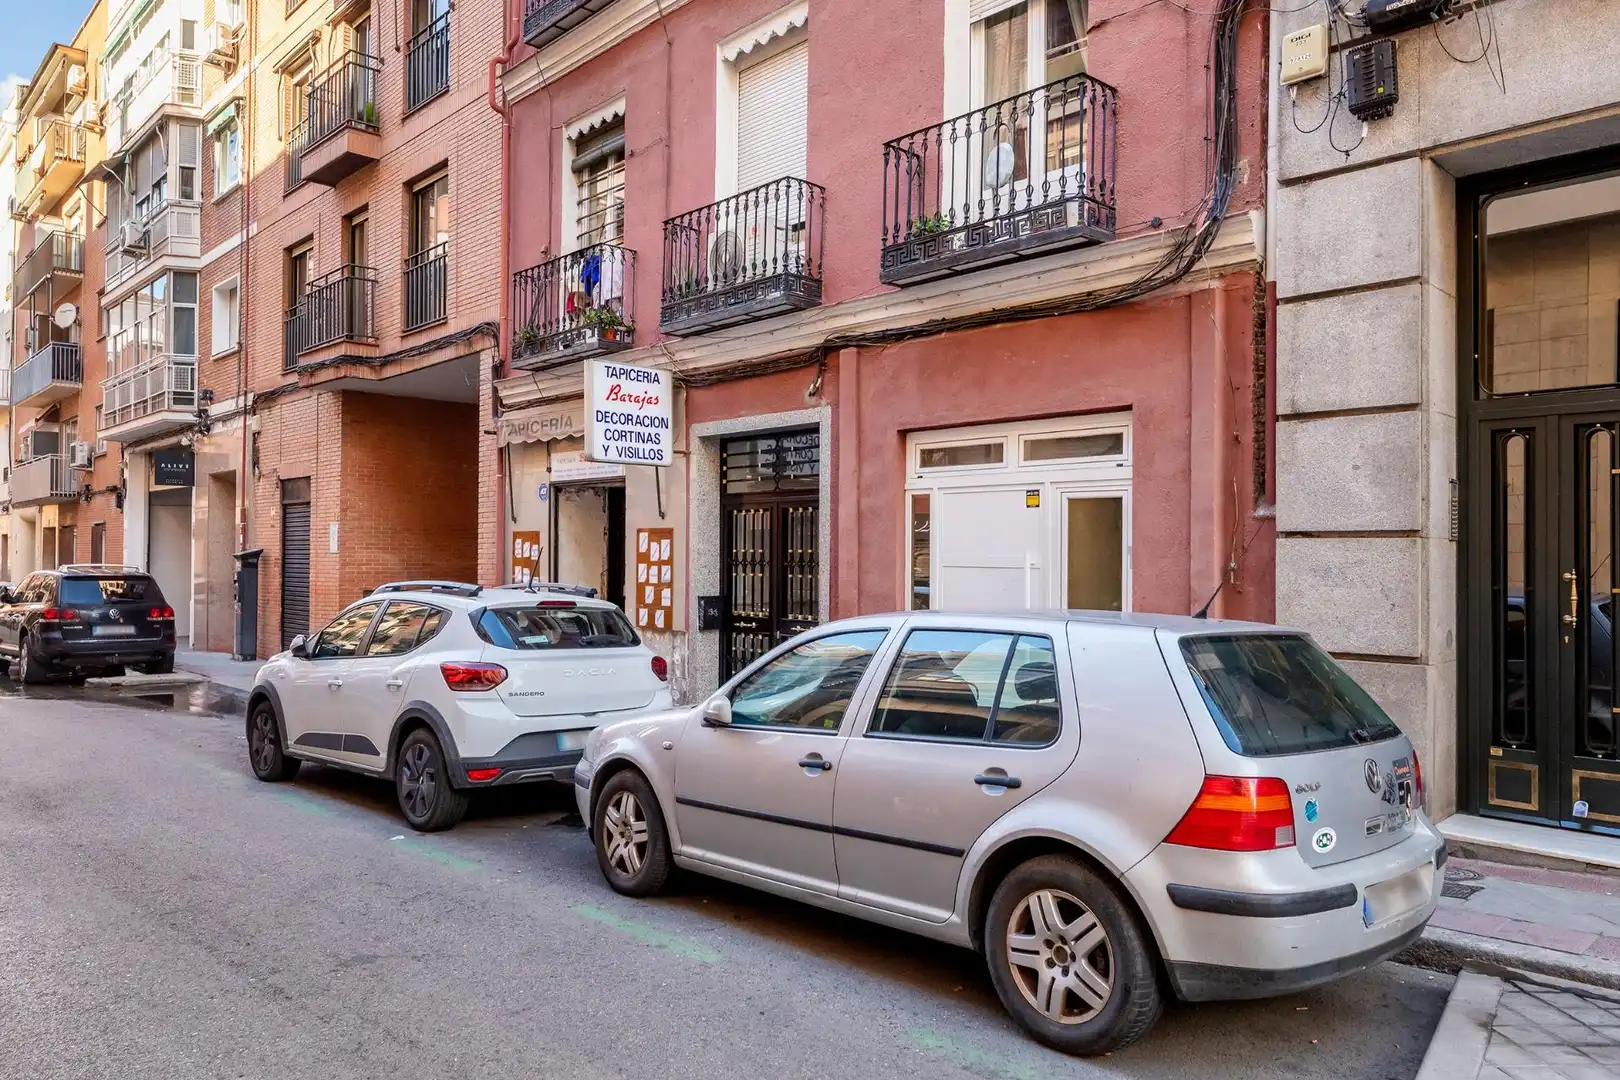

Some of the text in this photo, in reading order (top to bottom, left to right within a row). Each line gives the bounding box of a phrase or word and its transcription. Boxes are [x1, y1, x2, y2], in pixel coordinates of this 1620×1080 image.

[1290, 32, 1311, 43] DIGI
[604, 365, 660, 385] TAPICERIA
[605, 384, 660, 410] Barajas
[595, 410, 669, 429] DECORACION
[604, 428, 661, 445] CORTINAS
[602, 444, 664, 461] Y VISILLOS
